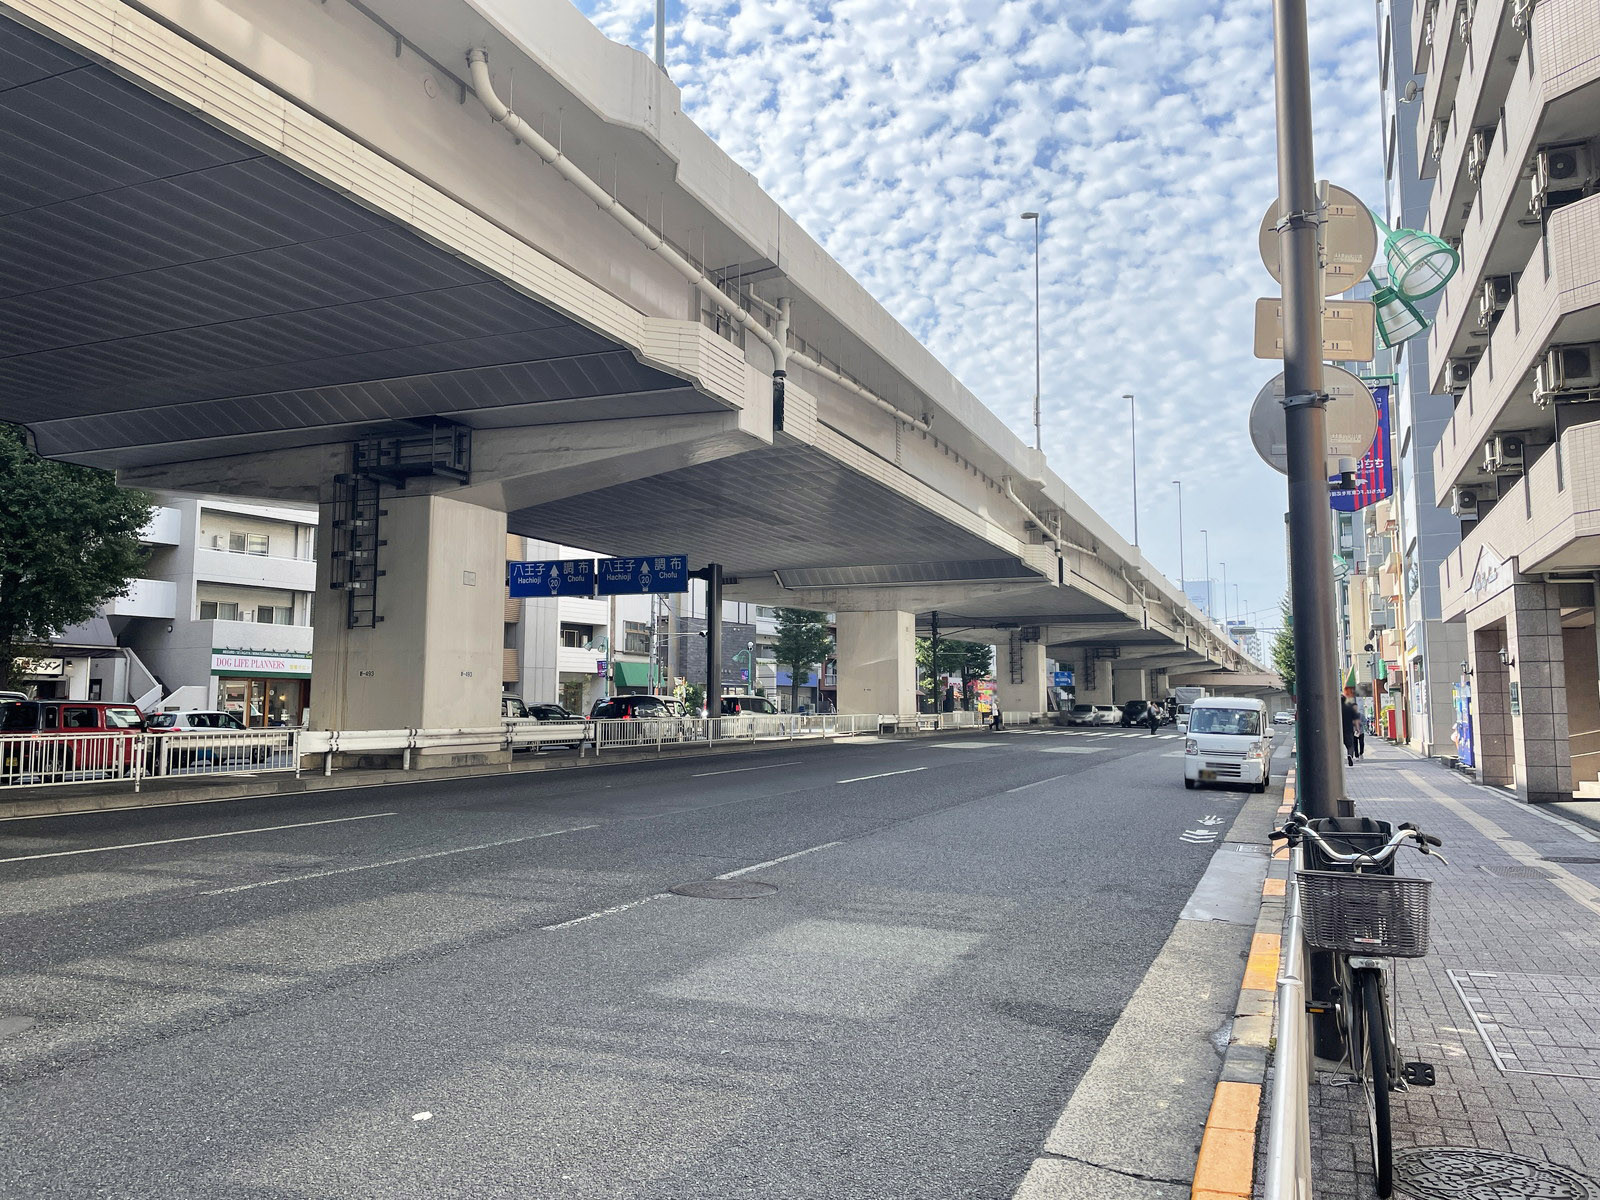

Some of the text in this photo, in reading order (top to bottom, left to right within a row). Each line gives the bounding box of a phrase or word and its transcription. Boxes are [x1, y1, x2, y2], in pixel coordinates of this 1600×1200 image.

[513, 561, 589, 576] 八王子 調布
[602, 557, 682, 572] 八王子 調布
[517, 575, 585, 585] Hachioji Chofu
[606, 571, 678, 581] Hachioji Chofu
[641, 575, 650, 584] 20
[550, 579, 559, 587] 20
[216, 657, 232, 667] DOG
[233, 658, 250, 668] LIFE
[251, 659, 285, 669] PLANNERS
